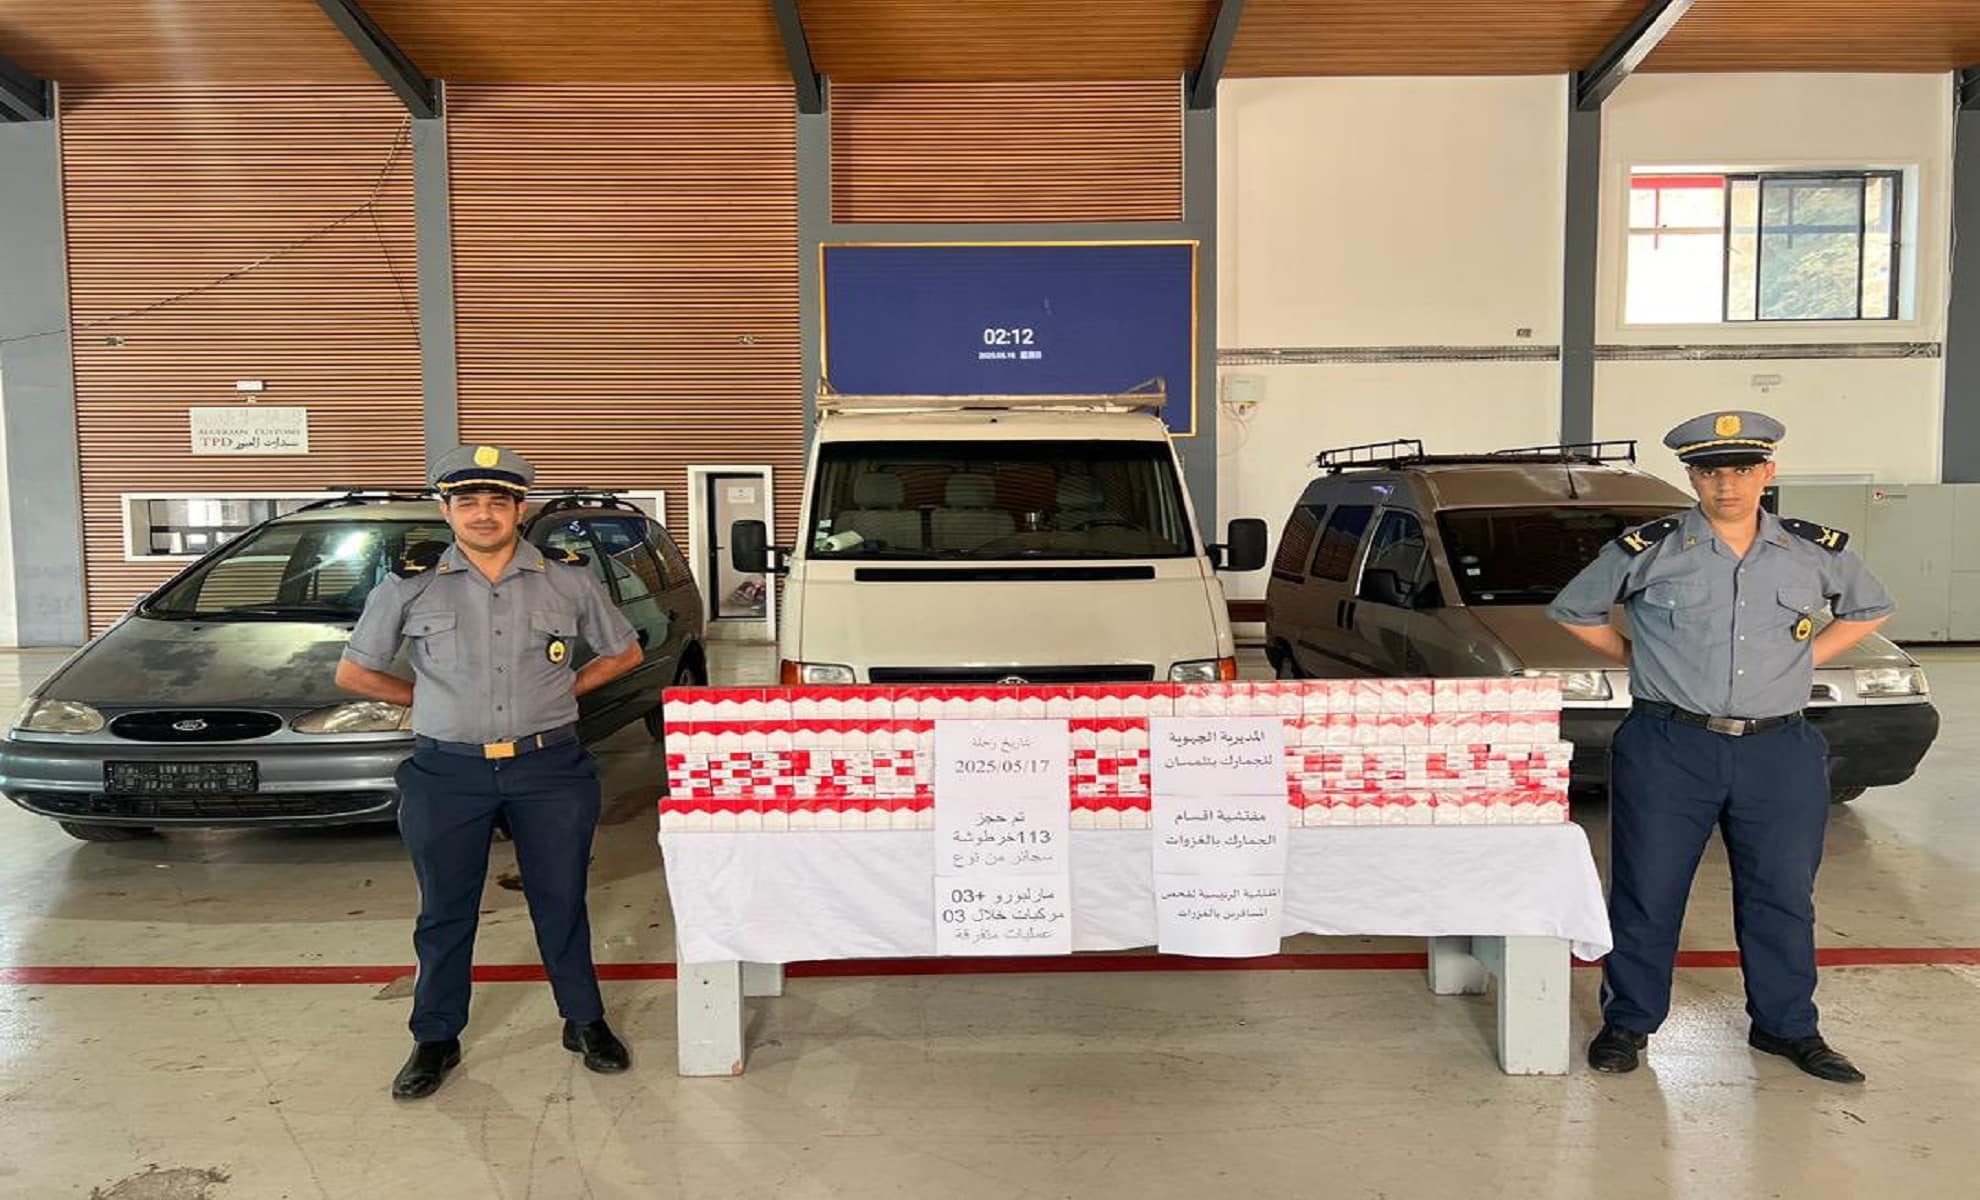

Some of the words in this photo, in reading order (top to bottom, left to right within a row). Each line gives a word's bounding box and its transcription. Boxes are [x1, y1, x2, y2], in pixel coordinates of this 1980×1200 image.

[984, 328, 1034, 345] 02:12
[201, 437, 234, 447] TPD
[955, 760, 1050, 773] 2025/05/17
[1224, 834, 1276, 848] الجمارك
[943, 909, 966, 923] 03
